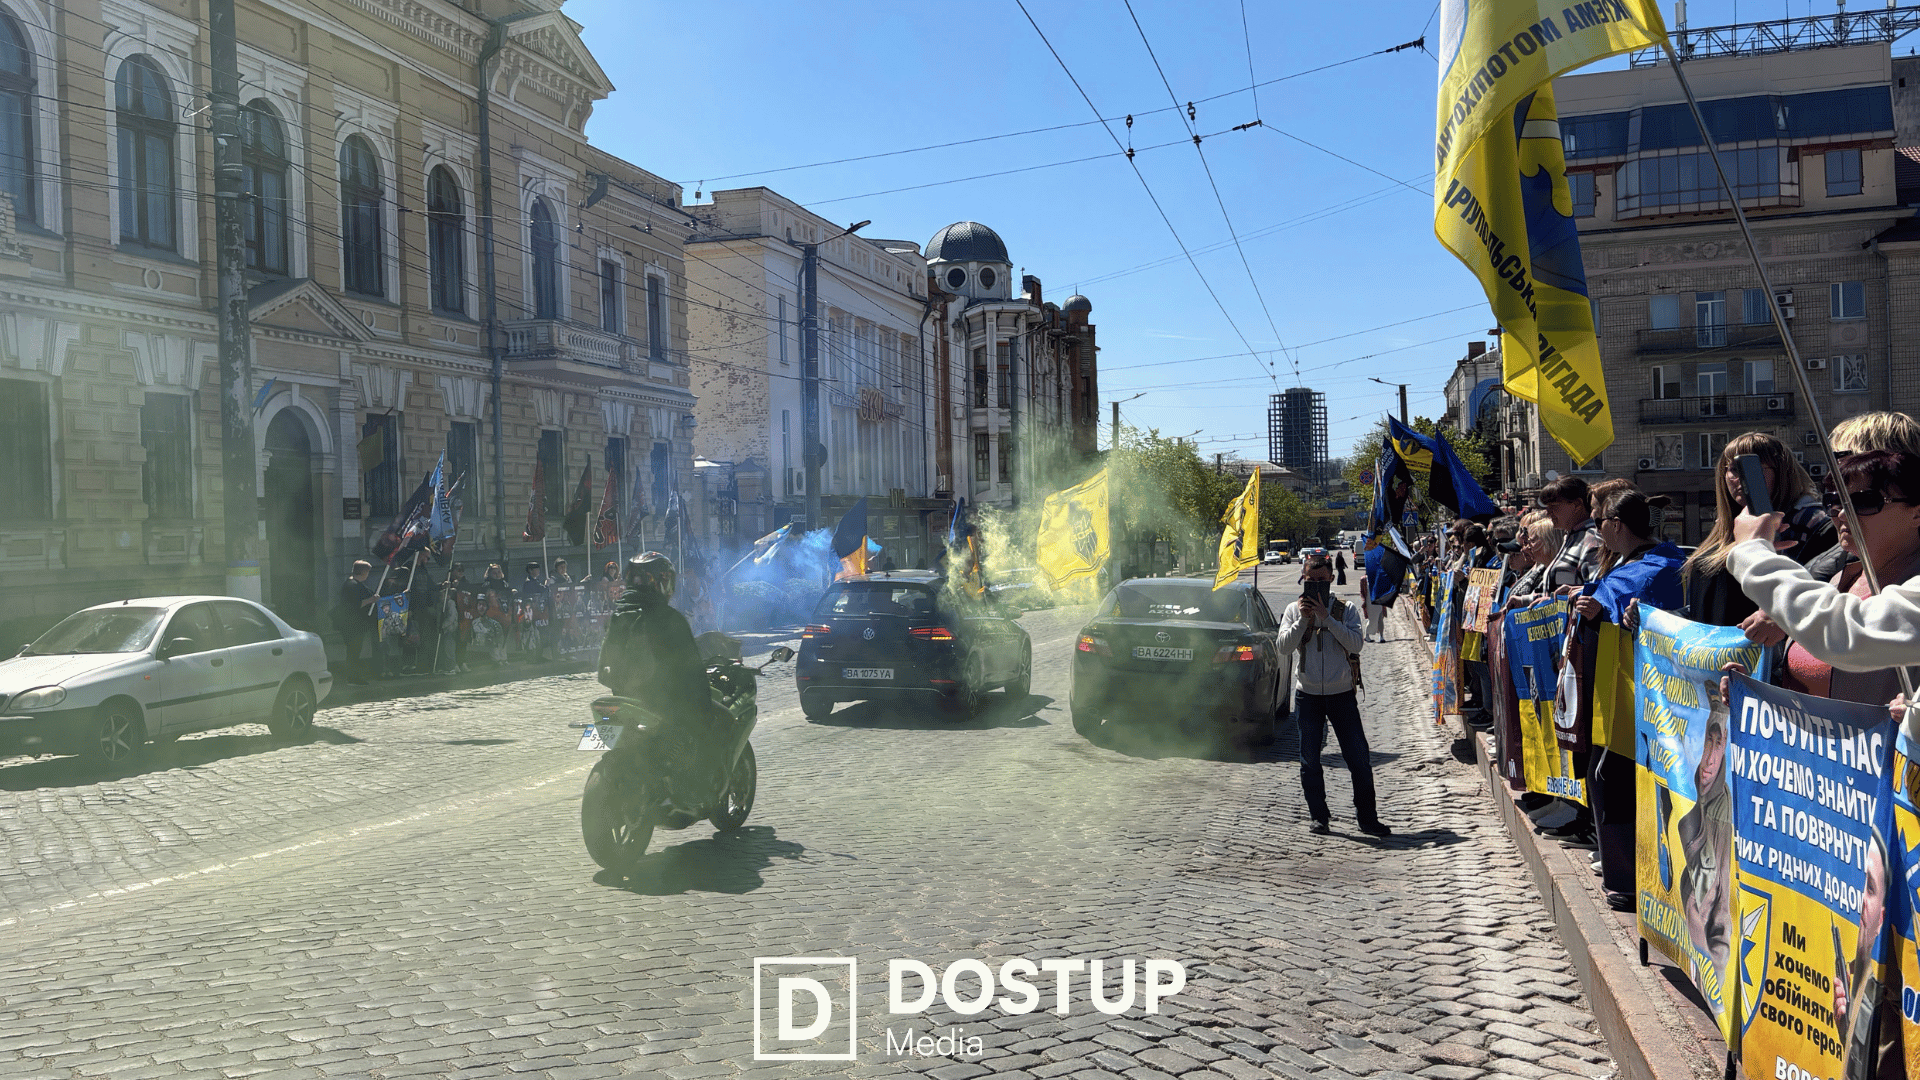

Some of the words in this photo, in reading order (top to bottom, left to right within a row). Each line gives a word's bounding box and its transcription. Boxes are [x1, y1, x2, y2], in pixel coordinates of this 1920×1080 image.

[847, 669, 859, 678] BA
[860, 669, 878, 678] 1075
[879, 670, 891, 679] YA
[1137, 648, 1152, 657] BA
[1153, 649, 1176, 658] 6224
[1177, 650, 1192, 659] HH
[1740, 696, 1837, 762] ПОЧУЙТЕ
[1838, 722, 1882, 779] НАС
[1747, 749, 1815, 800] ХОЧЕМО
[1751, 795, 1777, 831] ТА
[1768, 847, 1823, 891] РІДНИХ
[1824, 872, 1864, 914] ДОДОМ
[1782, 921, 1806, 952] Ми
[1774, 951, 1830, 993] хочемо
[1764, 978, 1834, 1029] обійняти
[1760, 1002, 1804, 1036] свого
[1807, 1024, 1843, 1062] героя
